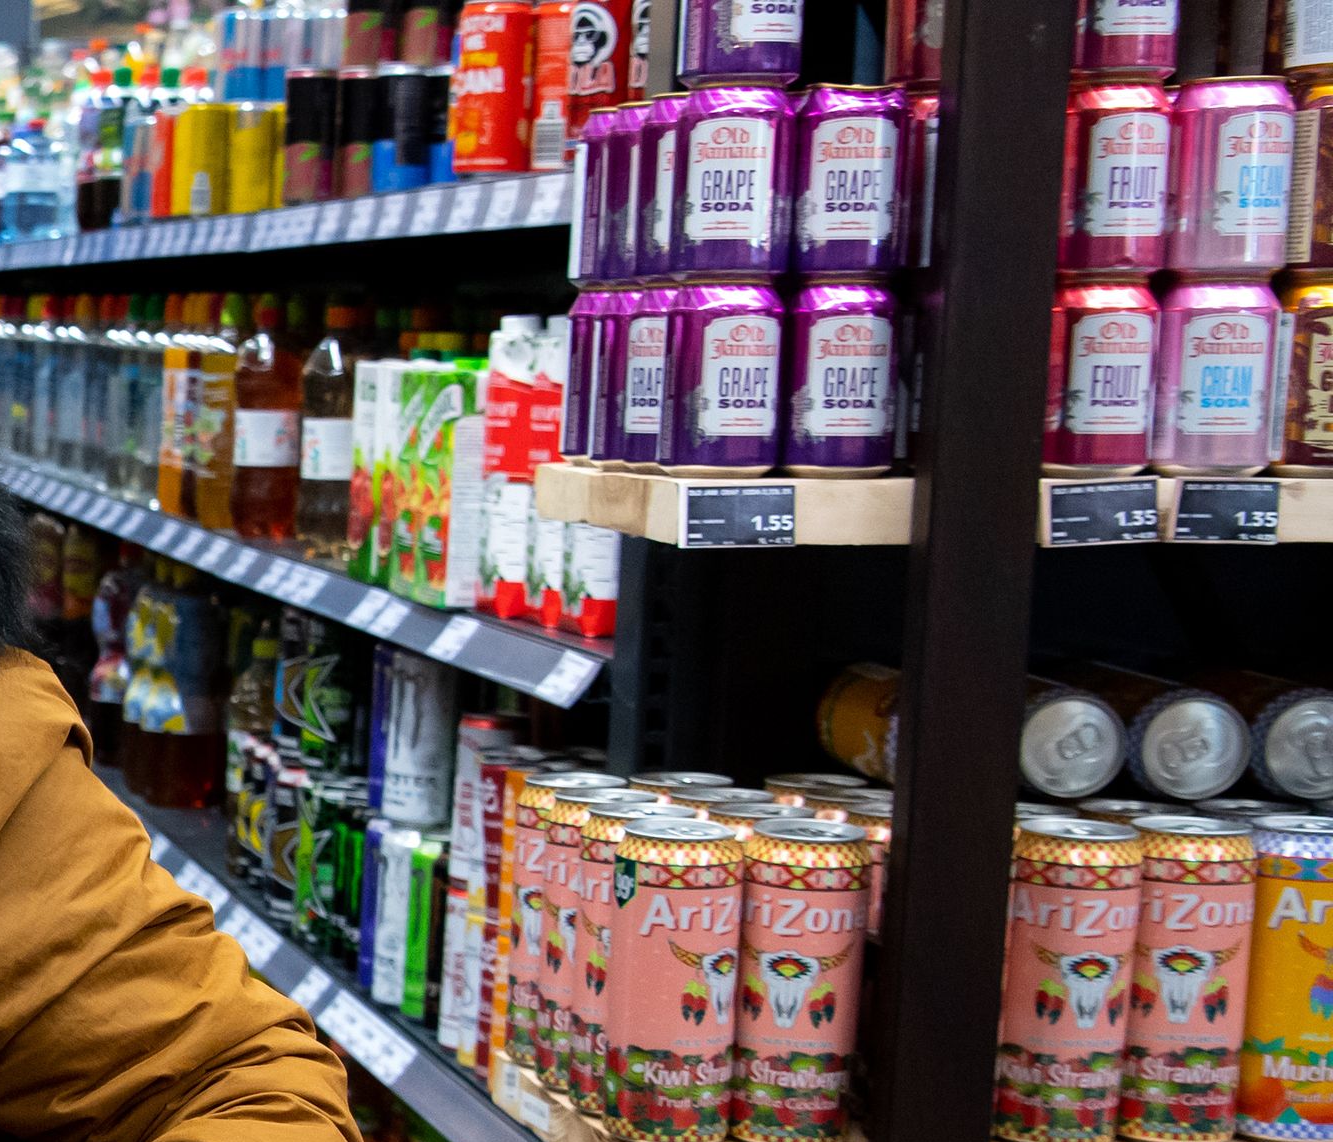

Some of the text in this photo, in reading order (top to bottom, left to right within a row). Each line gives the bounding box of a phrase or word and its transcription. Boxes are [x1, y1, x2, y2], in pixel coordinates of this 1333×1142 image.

[712, 126, 751, 146] Old
[837, 126, 876, 146] Old
[701, 170, 757, 201] GRAPE
[825, 170, 881, 201] GRAPE
[1109, 166, 1158, 201] FRUIT
[700, 201, 754, 213] SODA
[824, 201, 878, 213] SODA
[730, 324, 765, 342] Old
[836, 323, 874, 342] Old
[719, 367, 769, 398] GRAPE
[823, 367, 879, 398] GRAPE
[1091, 365, 1142, 399] FRUIT
[718, 398, 767, 409] SODA
[823, 398, 877, 409] SODA
[1200, 398, 1251, 408] SODA
[751, 514, 794, 531] 1.55
[1114, 509, 1158, 527] 1.35
[1234, 511, 1278, 528] 1.35
[639, 893, 739, 936] AriZ
